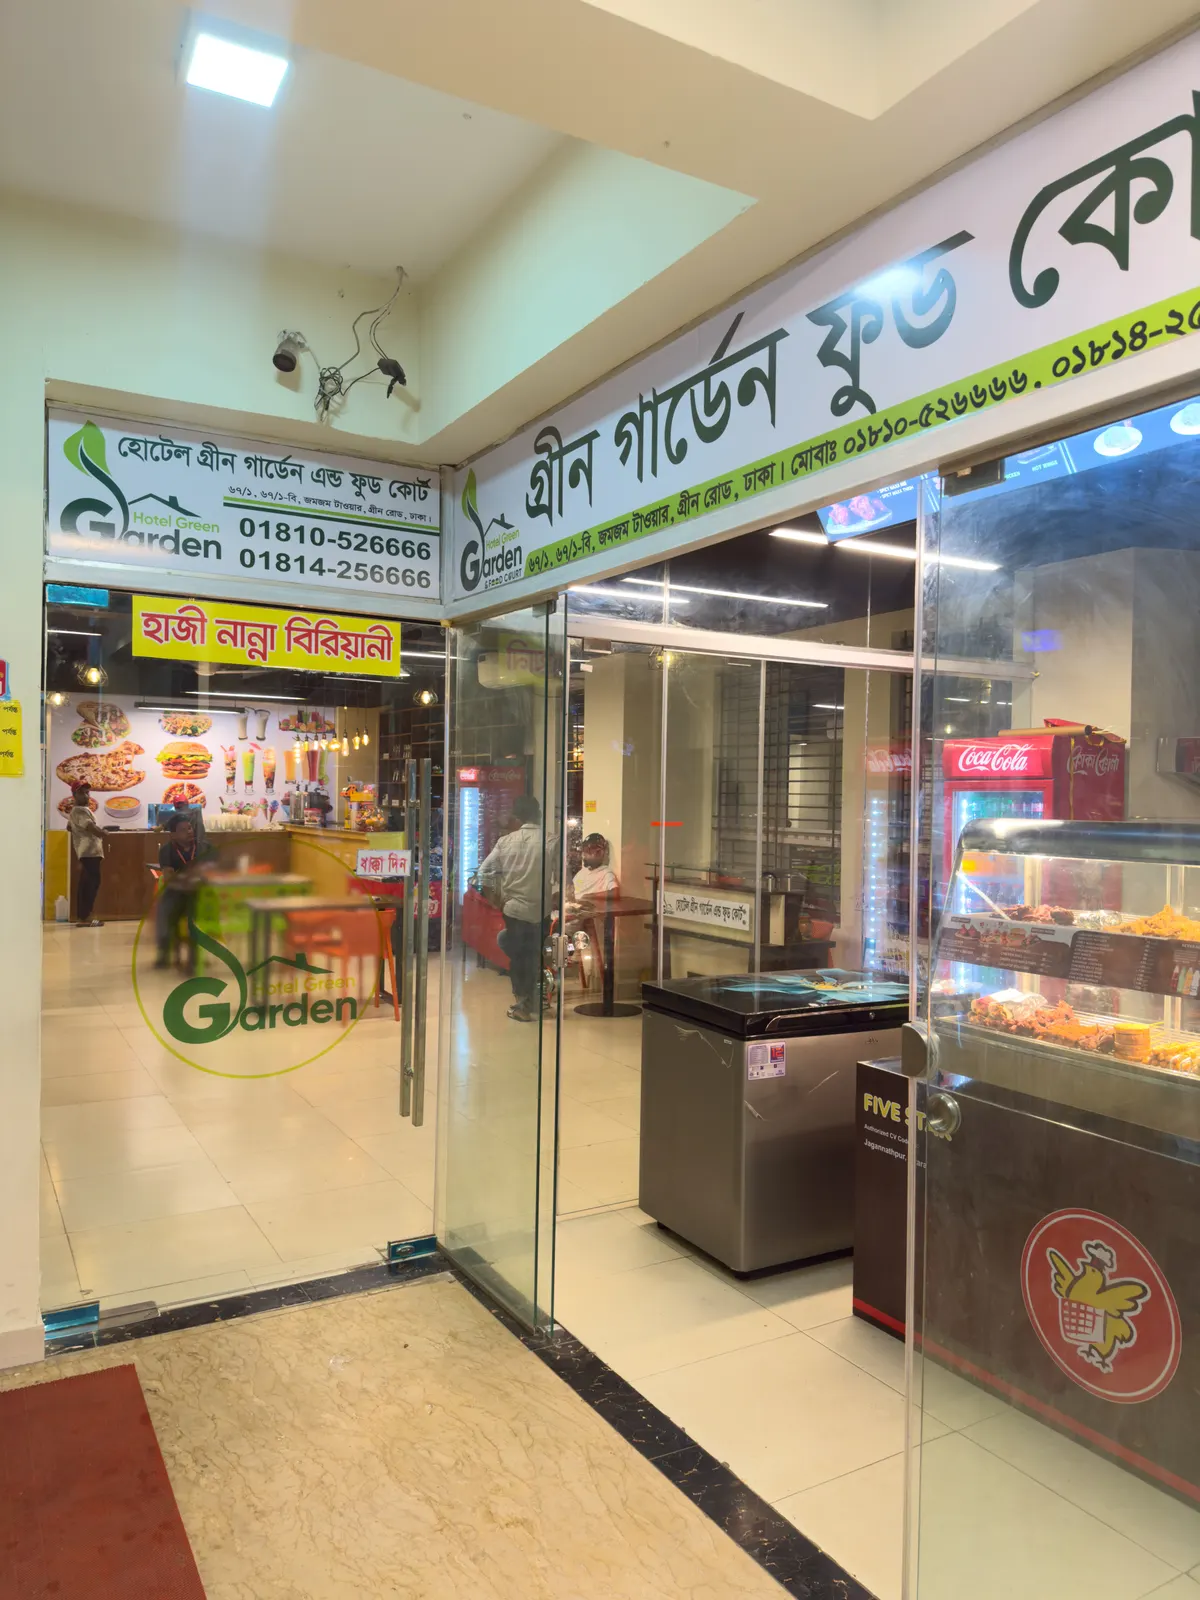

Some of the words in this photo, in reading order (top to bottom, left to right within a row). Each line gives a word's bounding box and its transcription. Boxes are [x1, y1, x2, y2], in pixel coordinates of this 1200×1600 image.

[526, 426, 600, 526] গ্রীন
[615, 311, 790, 483] গার্ডেন
[805, 229, 976, 417] ফুড
[118, 434, 193, 468] হোটেল
[197, 441, 238, 474] গ্রীন
[244, 455, 305, 485] গার্ডেন
[311, 467, 345, 488] এন্ড
[350, 472, 383, 501] ফুড
[388, 477, 431, 502] কোর্ট
[133, 511, 172, 528] Hotel
[176, 517, 220, 533] Green
[303, 496, 331, 508] জমজম
[368, 503, 384, 516] গ্রীন
[598, 520, 630, 546] জমজম
[677, 491, 701, 518] গ্রীন
[59, 497, 222, 560] Garden
[239, 517, 431, 560] 01810-526666
[486, 534, 500, 551] Hotel
[502, 529, 520, 545] Green
[239, 548, 431, 588] 01814-256666
[461, 540, 522, 592] Garden
[504, 568, 522, 582] COURT
[141, 604, 208, 646] হাজী
[215, 618, 278, 662] নান্না
[284, 616, 394, 661] বিরিয়ানী
[958, 743, 1029, 771] Coca-Cola
[388, 852, 408, 873] দিন
[253, 977, 299, 998] Hotel
[304, 976, 356, 993] Green
[162, 976, 357, 1044] Garden
[863, 1093, 901, 1122] FIVE
[864, 1138, 907, 1162] Jagannathpur,
